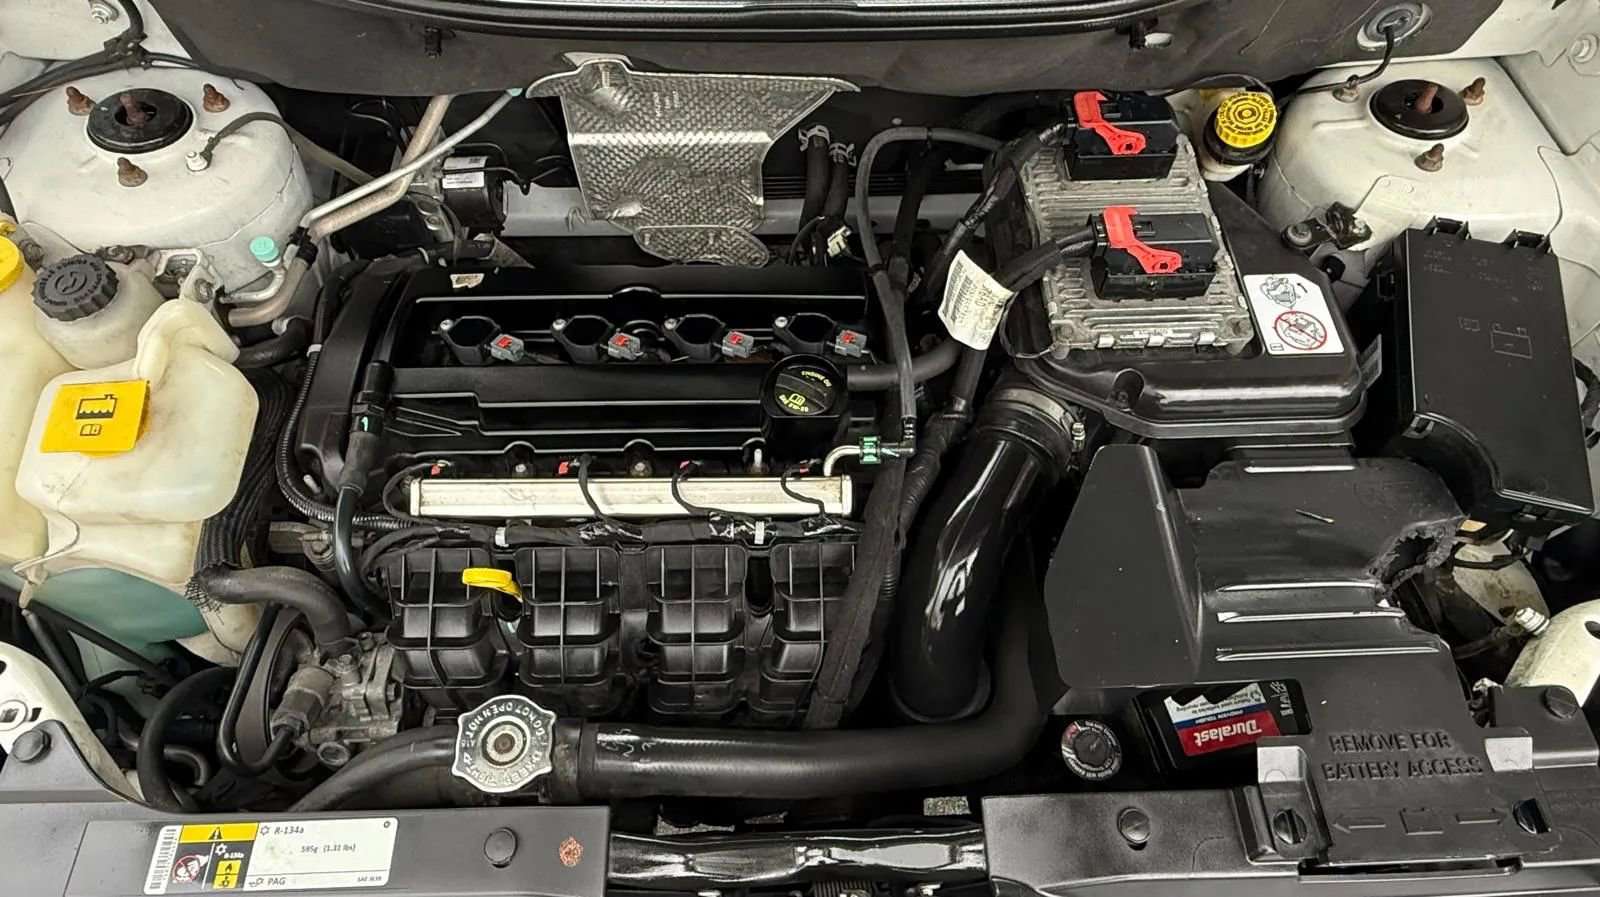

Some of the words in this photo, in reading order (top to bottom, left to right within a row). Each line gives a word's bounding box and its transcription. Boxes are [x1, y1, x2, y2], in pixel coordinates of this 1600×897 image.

[801, 370, 825, 380] ENGINE
[482, 702, 513, 718] OPEN
[1195, 716, 1217, 724] TOUGH
[1194, 719, 1262, 746] Duralast
[1329, 733, 1409, 752] REMOVE
[1410, 731, 1452, 750] FOR
[503, 761, 536, 786] KEEP
[1321, 759, 1400, 781] BATTERY
[1408, 756, 1483, 779] ACCESS
[274, 825, 305, 835] R-134a
[301, 845, 318, 854] 595g
[342, 843, 356, 852] lbs)
[267, 877, 286, 886] PAG
